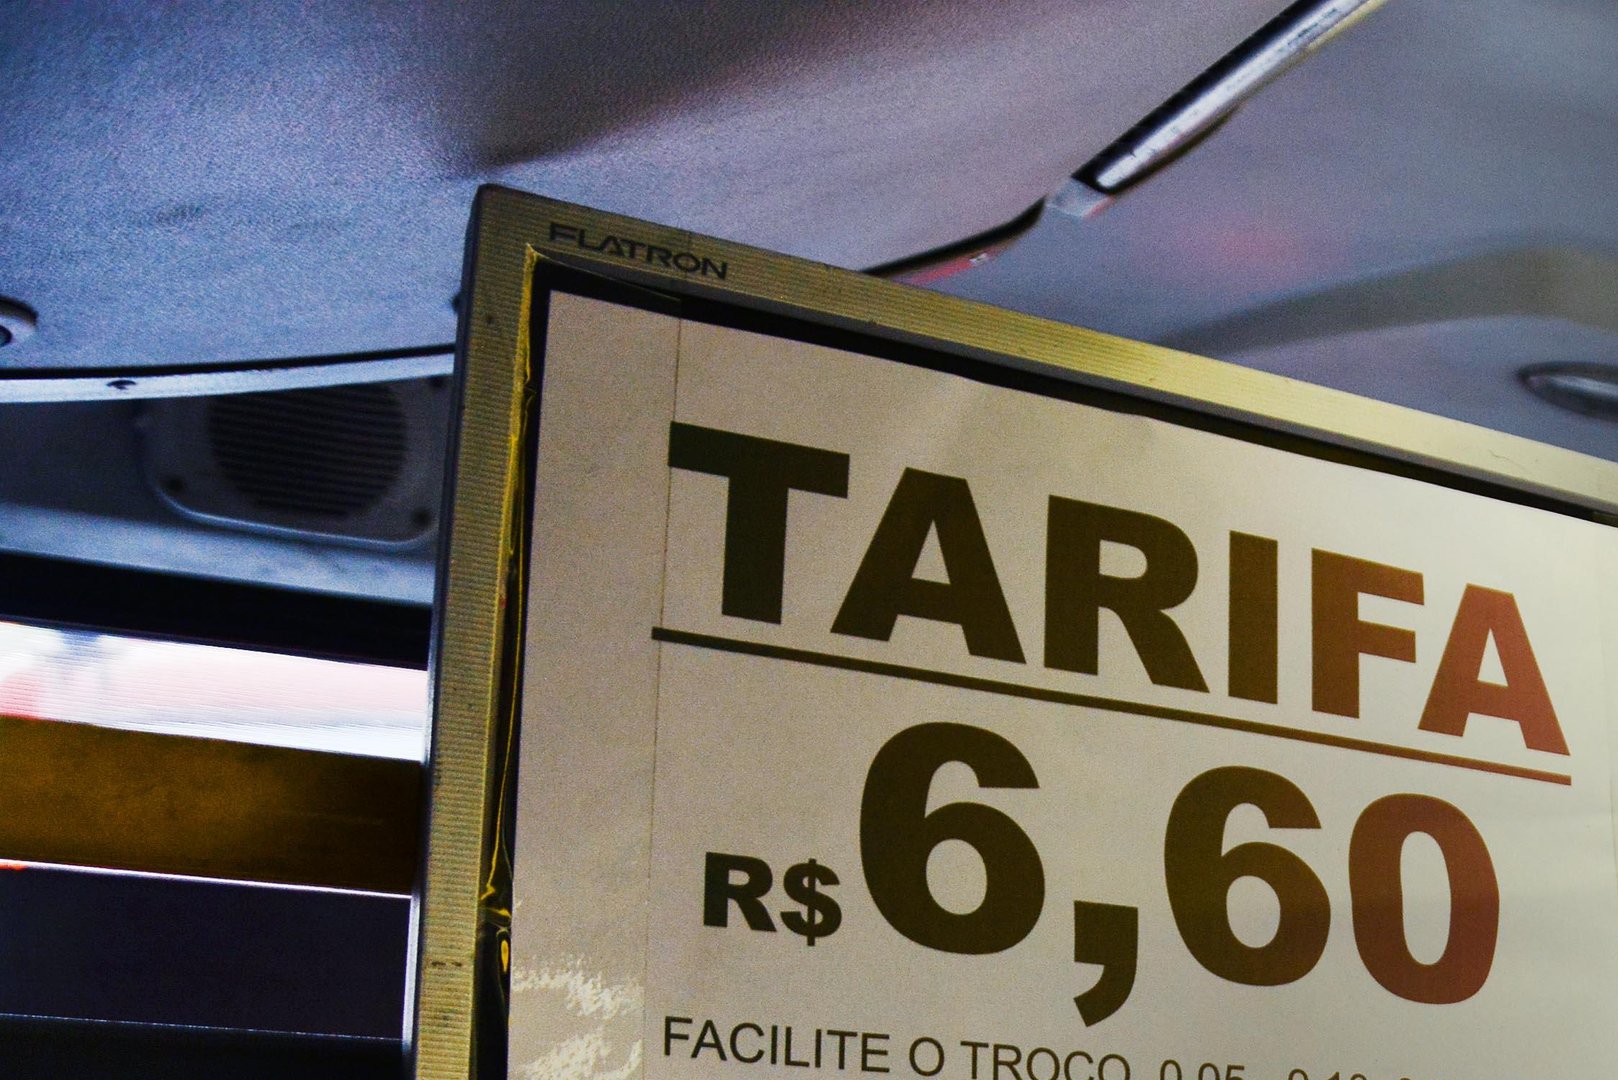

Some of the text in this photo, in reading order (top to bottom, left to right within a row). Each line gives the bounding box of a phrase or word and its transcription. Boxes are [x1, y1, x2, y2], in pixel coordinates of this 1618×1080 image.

[549, 222, 728, 280] FLATRON
[668, 421, 1571, 755] TARIFA
[702, 721, 1500, 1025] R$ 6,60
[662, 1016, 891, 1074] FACILITE
[908, 1036, 945, 1078] O
